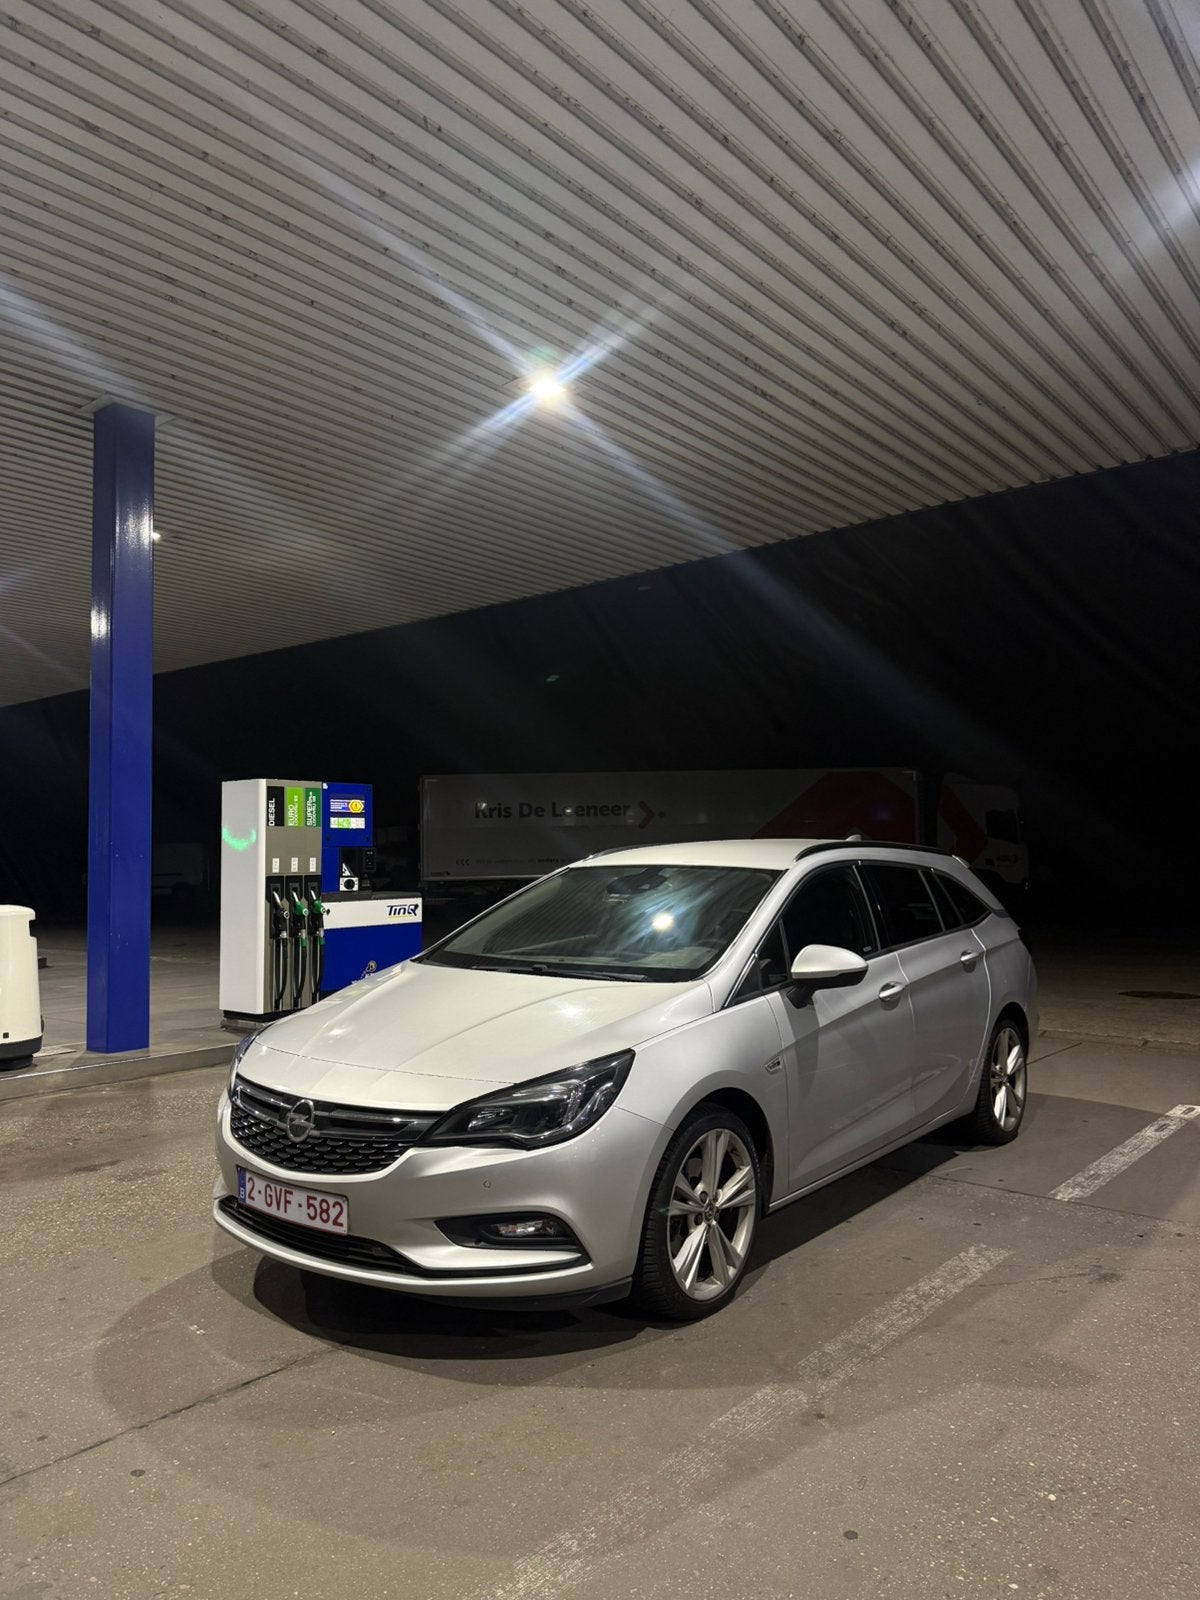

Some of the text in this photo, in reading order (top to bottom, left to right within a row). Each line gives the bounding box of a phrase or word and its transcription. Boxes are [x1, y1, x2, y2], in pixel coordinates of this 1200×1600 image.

[475, 801, 512, 818] Kris
[519, 802, 545, 818] De
[247, 1177, 344, 1228] 2-GVF-582
